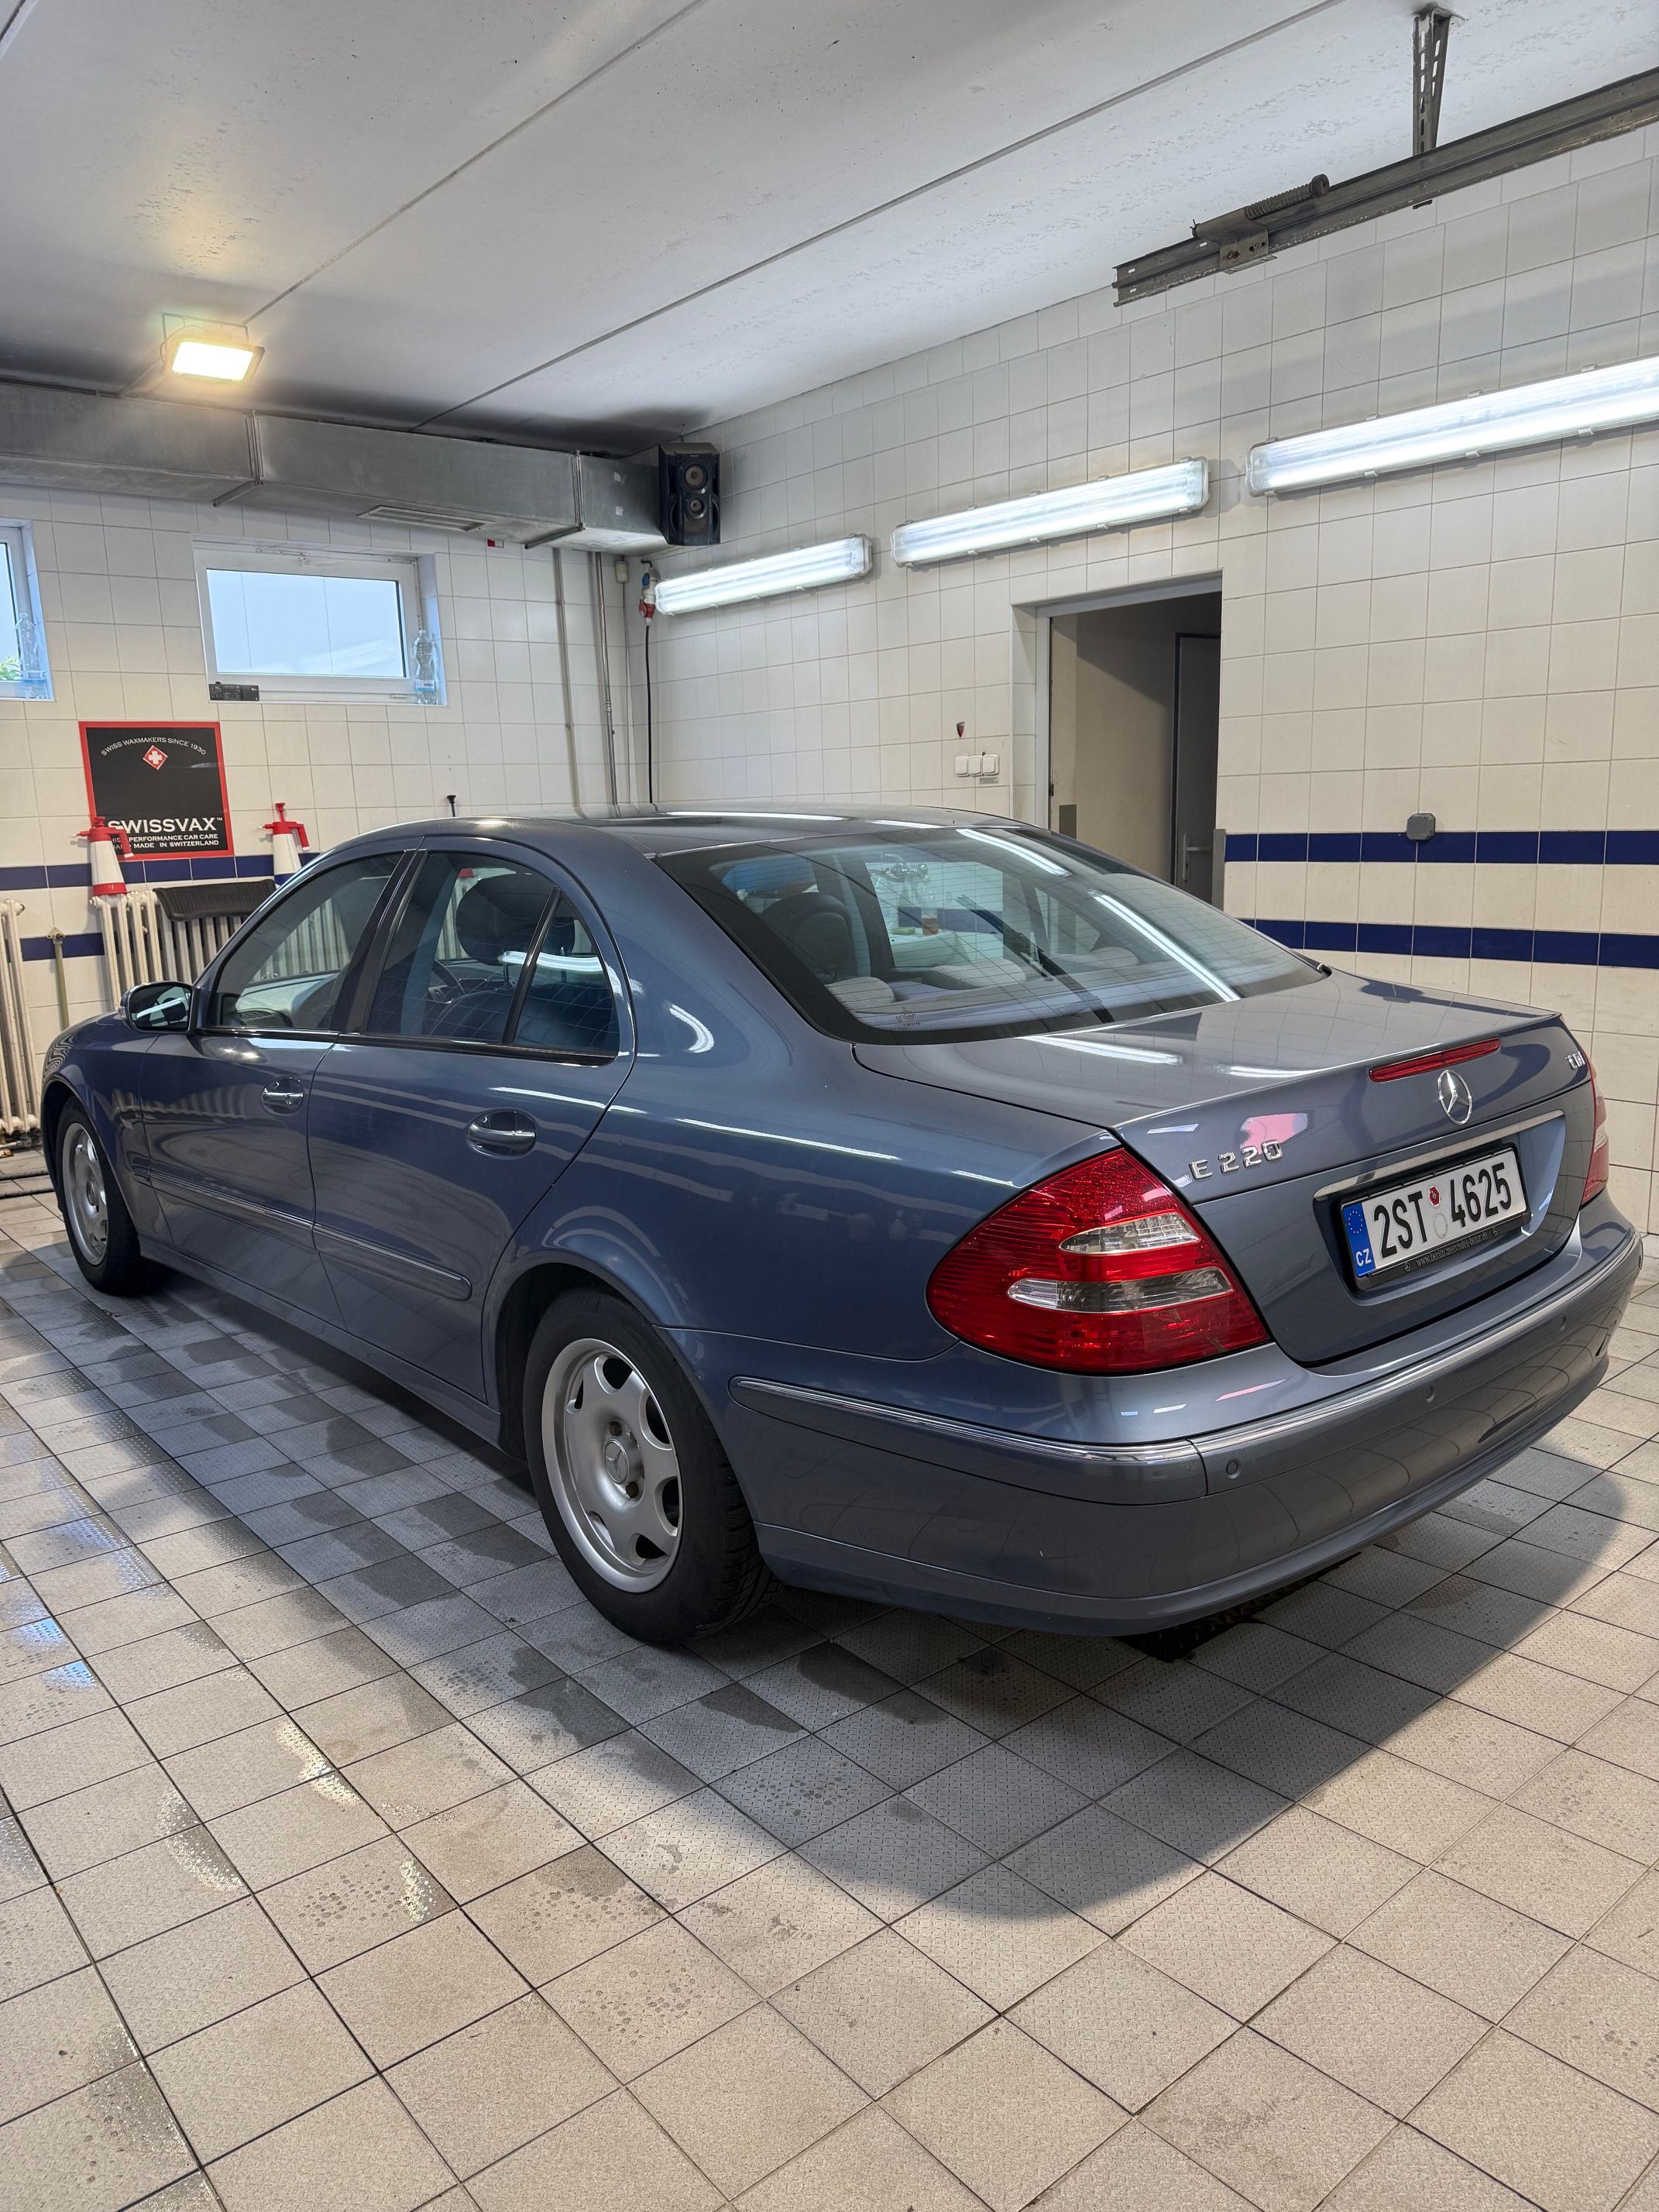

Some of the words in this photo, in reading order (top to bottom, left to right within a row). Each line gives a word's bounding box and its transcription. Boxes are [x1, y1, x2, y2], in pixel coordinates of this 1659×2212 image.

[101, 741, 122, 756] SWISS
[122, 737, 167, 746] WAXMAKERS
[167, 737, 189, 747] SINCE
[191, 743, 206, 755] 1930
[1189, 1159, 1214, 1180] E
[1218, 1139, 1283, 1174] 220
[1373, 1190, 1428, 1259] 2ST
[1449, 1162, 1512, 1228] 4625
[1355, 1248, 1372, 1266] CZ
